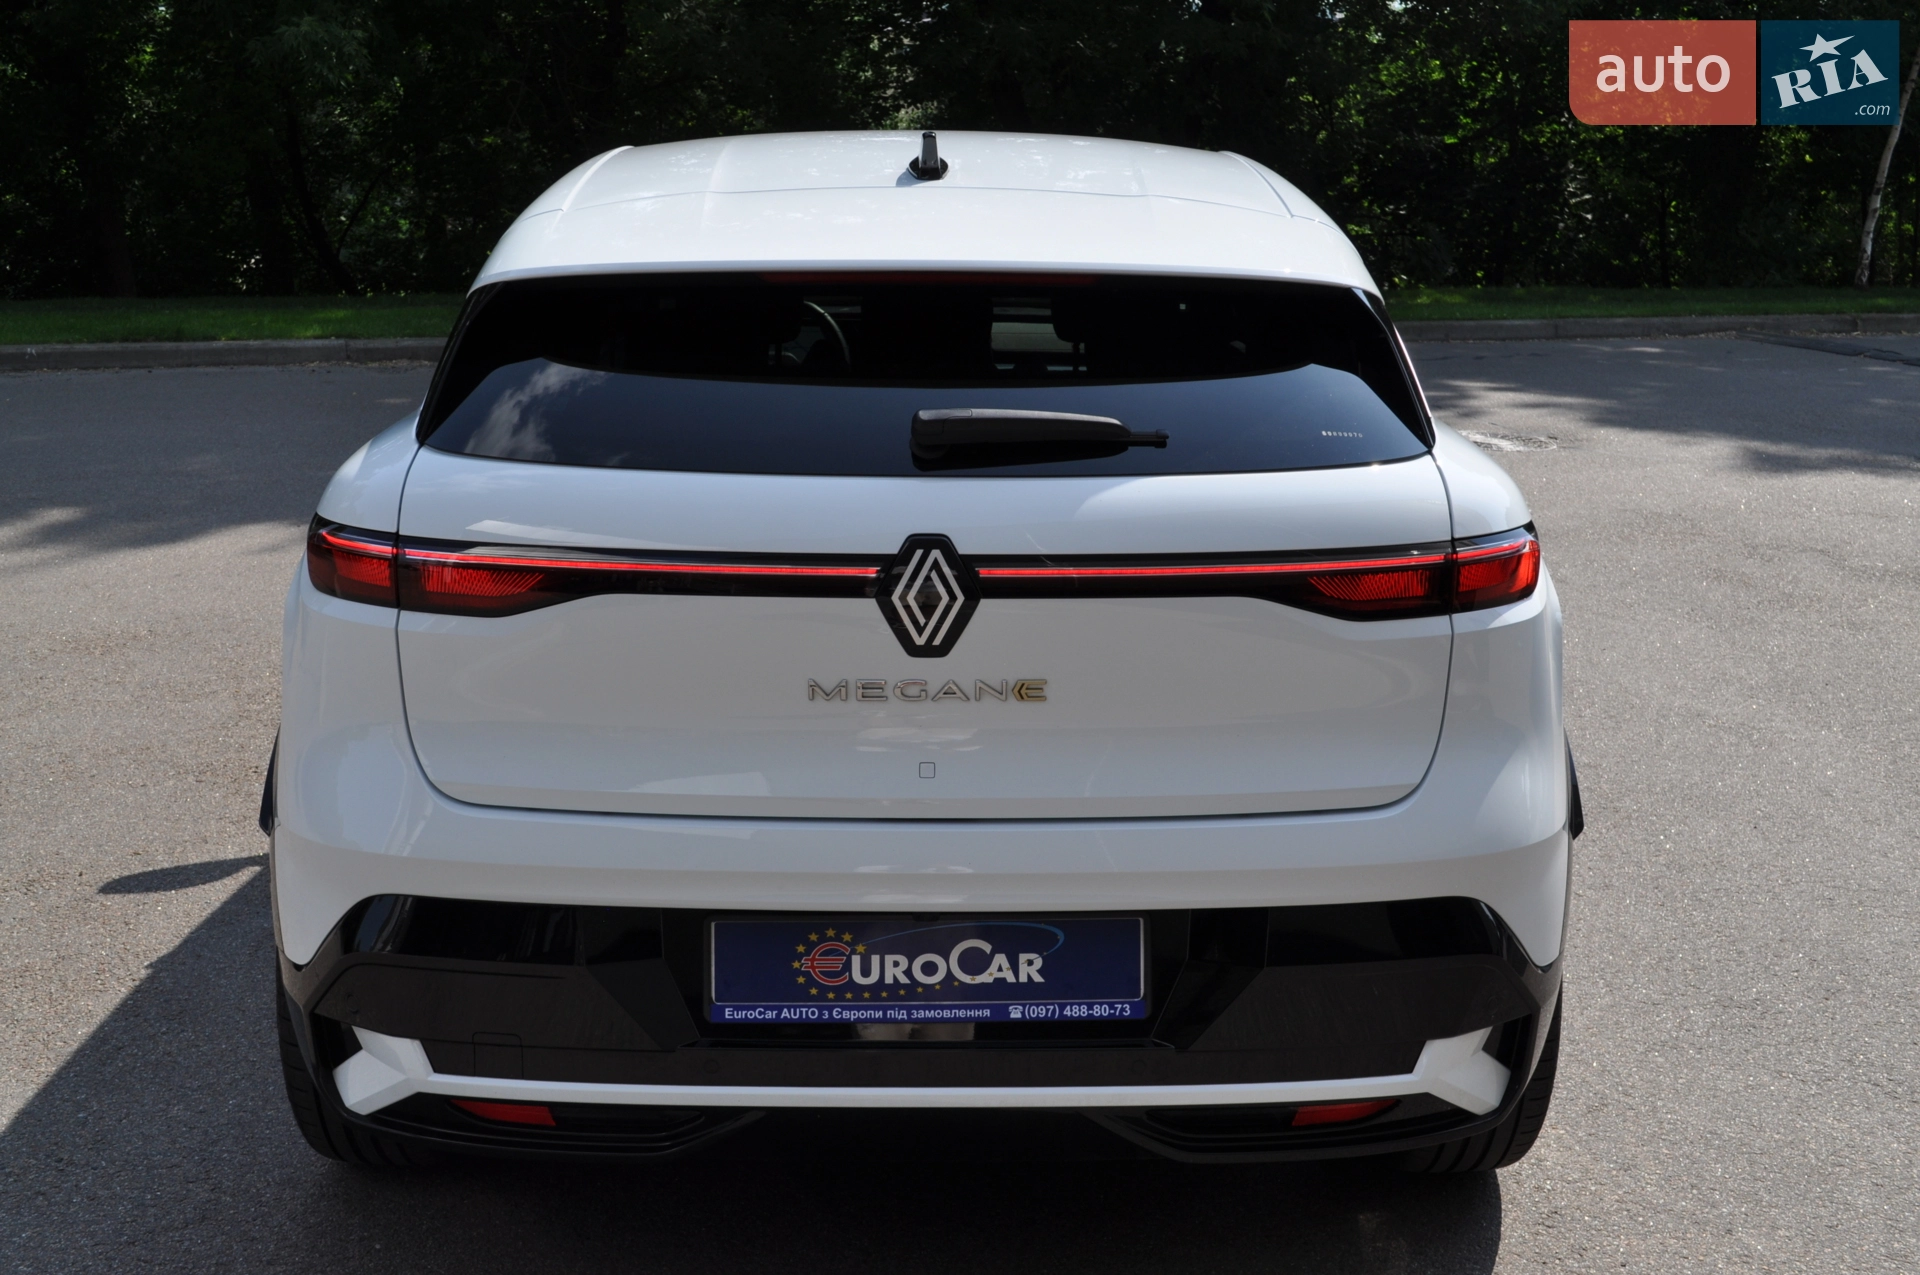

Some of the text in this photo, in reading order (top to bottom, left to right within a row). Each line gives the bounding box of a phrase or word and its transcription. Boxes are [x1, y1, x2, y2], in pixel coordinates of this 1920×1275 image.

[807, 678, 1048, 701] MEGANE
[724, 1007, 778, 1019] EuroCar
[780, 1007, 819, 1019] AUTO
[832, 1007, 883, 1021] Європи
[886, 1007, 907, 1020] під
[910, 1008, 991, 1019] замовлення
[1024, 1004, 1131, 1018] (097) 488-80-73
